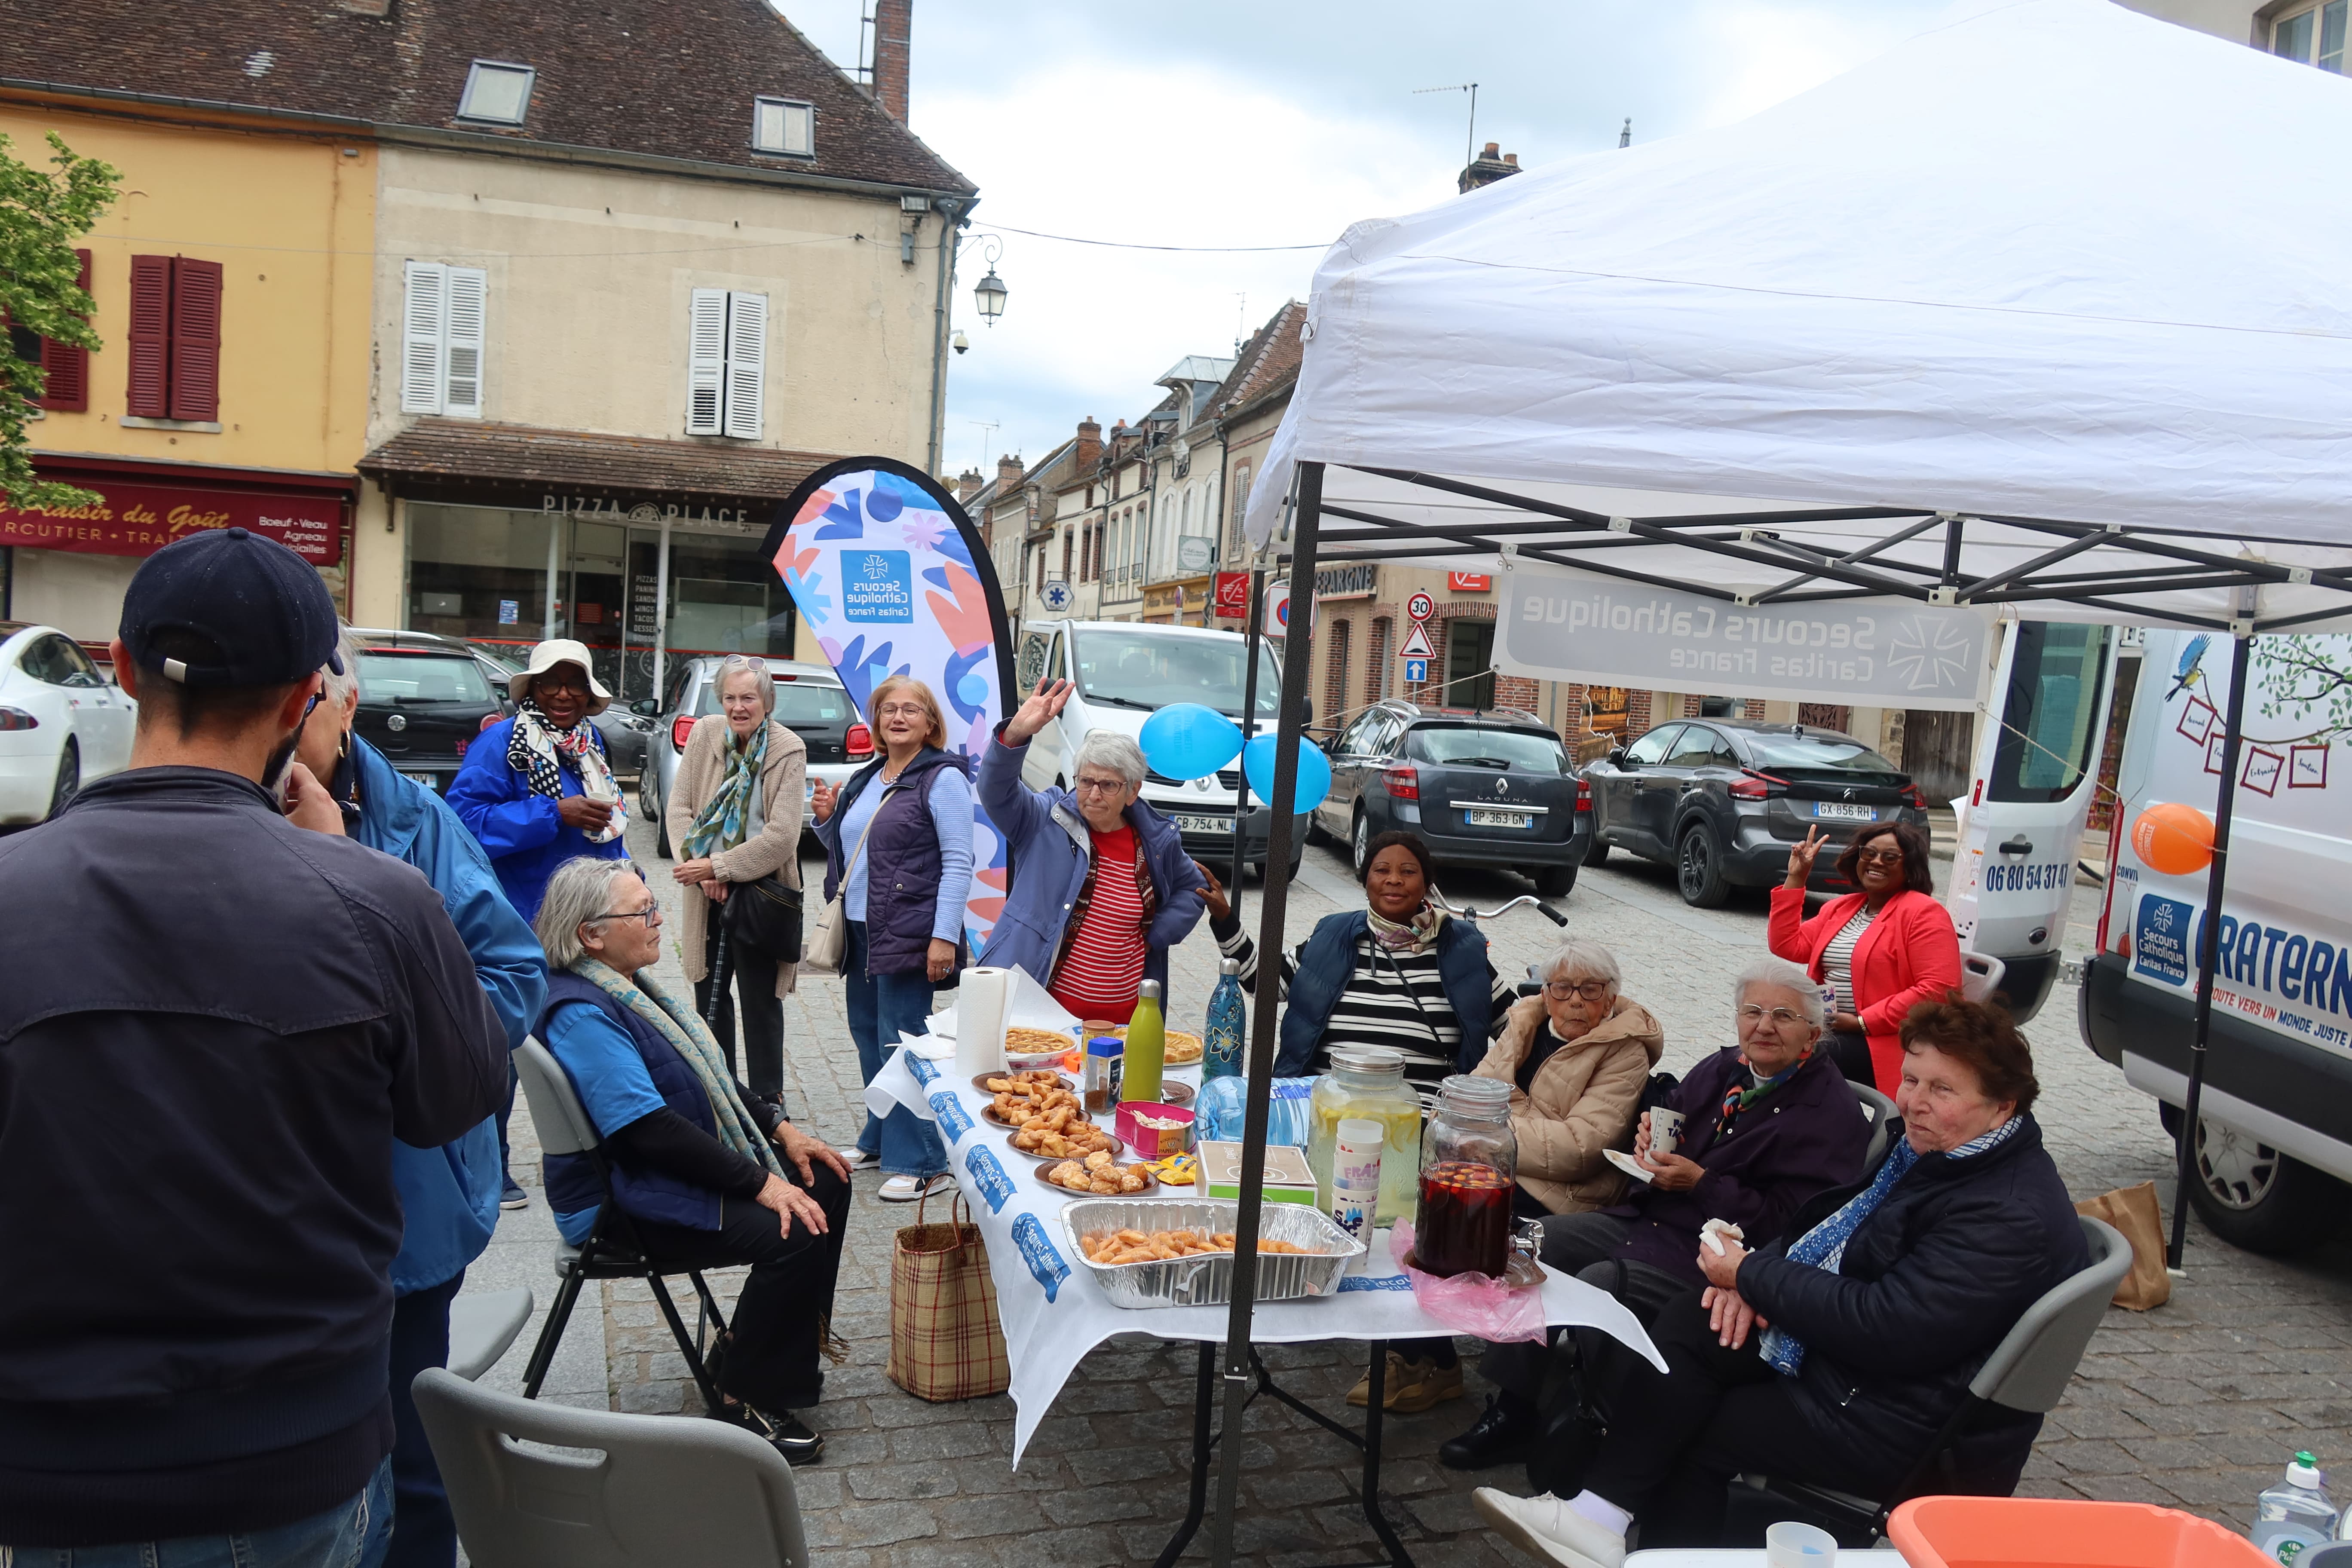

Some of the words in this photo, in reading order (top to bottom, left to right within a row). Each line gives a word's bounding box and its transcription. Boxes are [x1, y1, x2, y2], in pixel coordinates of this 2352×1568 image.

[122, 503, 157, 524] du
[167, 504, 230, 533] Goût
[543, 495, 620, 521] PIZZA
[667, 504, 747, 530] PLACE
[299, 518, 328, 530] Veau
[283, 530, 328, 542] Agneau
[636, 575, 657, 583] PIZZAS
[1412, 601, 1428, 613] 30
[1473, 812, 1525, 824] BP-363-GN
[1821, 804, 1869, 818] GX-856-RH
[1176, 817, 1229, 831] CB-754-NL
[1986, 865, 2005, 891] 06
[2006, 865, 2024, 891] 80
[2026, 864, 2043, 891] 54
[2044, 864, 2058, 889] 37
[2058, 864, 2069, 888] 47
[2144, 927, 2178, 949] Secours
[2139, 939, 2184, 965] Catholique
[2139, 955, 2162, 971] Caritas
[2163, 963, 2184, 979] France
[2211, 987, 2236, 1006] OUTE
[2238, 995, 2261, 1016] VERS
[2263, 1005, 2277, 1021] UN
[2278, 1011, 2312, 1034] MONDE
[2314, 1023, 2348, 1047] JUSTE
